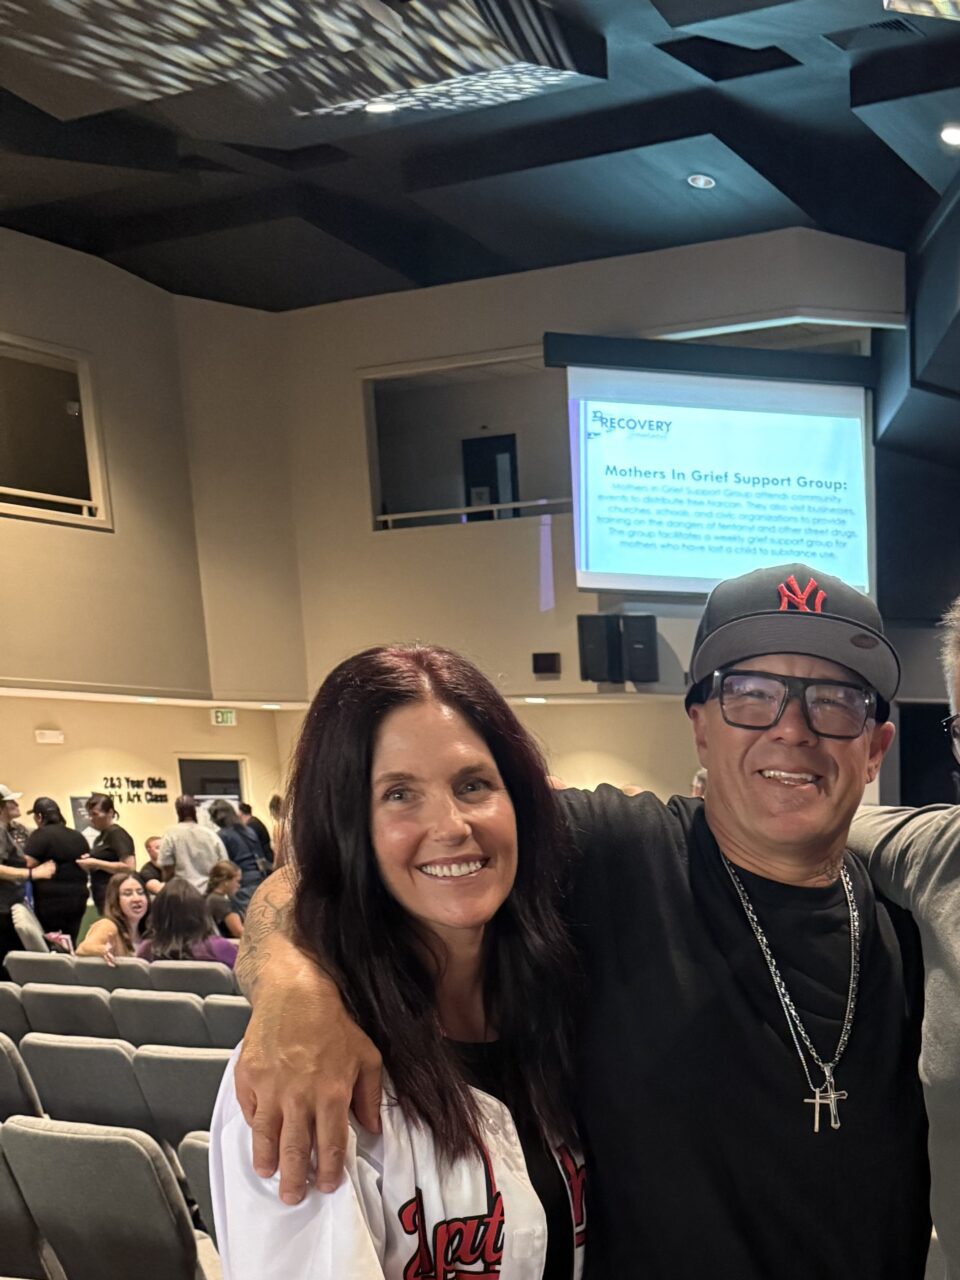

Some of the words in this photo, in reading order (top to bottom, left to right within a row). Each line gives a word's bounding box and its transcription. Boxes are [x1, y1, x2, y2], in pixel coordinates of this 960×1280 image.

[600, 416, 672, 432] RECOVERY
[605, 465, 665, 480] Mothers
[671, 468, 686, 481] In
[691, 470, 728, 484] Grief
[734, 472, 791, 488] Support
[797, 476, 848, 491] Group:
[776, 574, 827, 613] NY
[215, 710, 233, 724] EXIT
[103, 777, 121, 789] 2&3
[124, 777, 145, 789] Year
